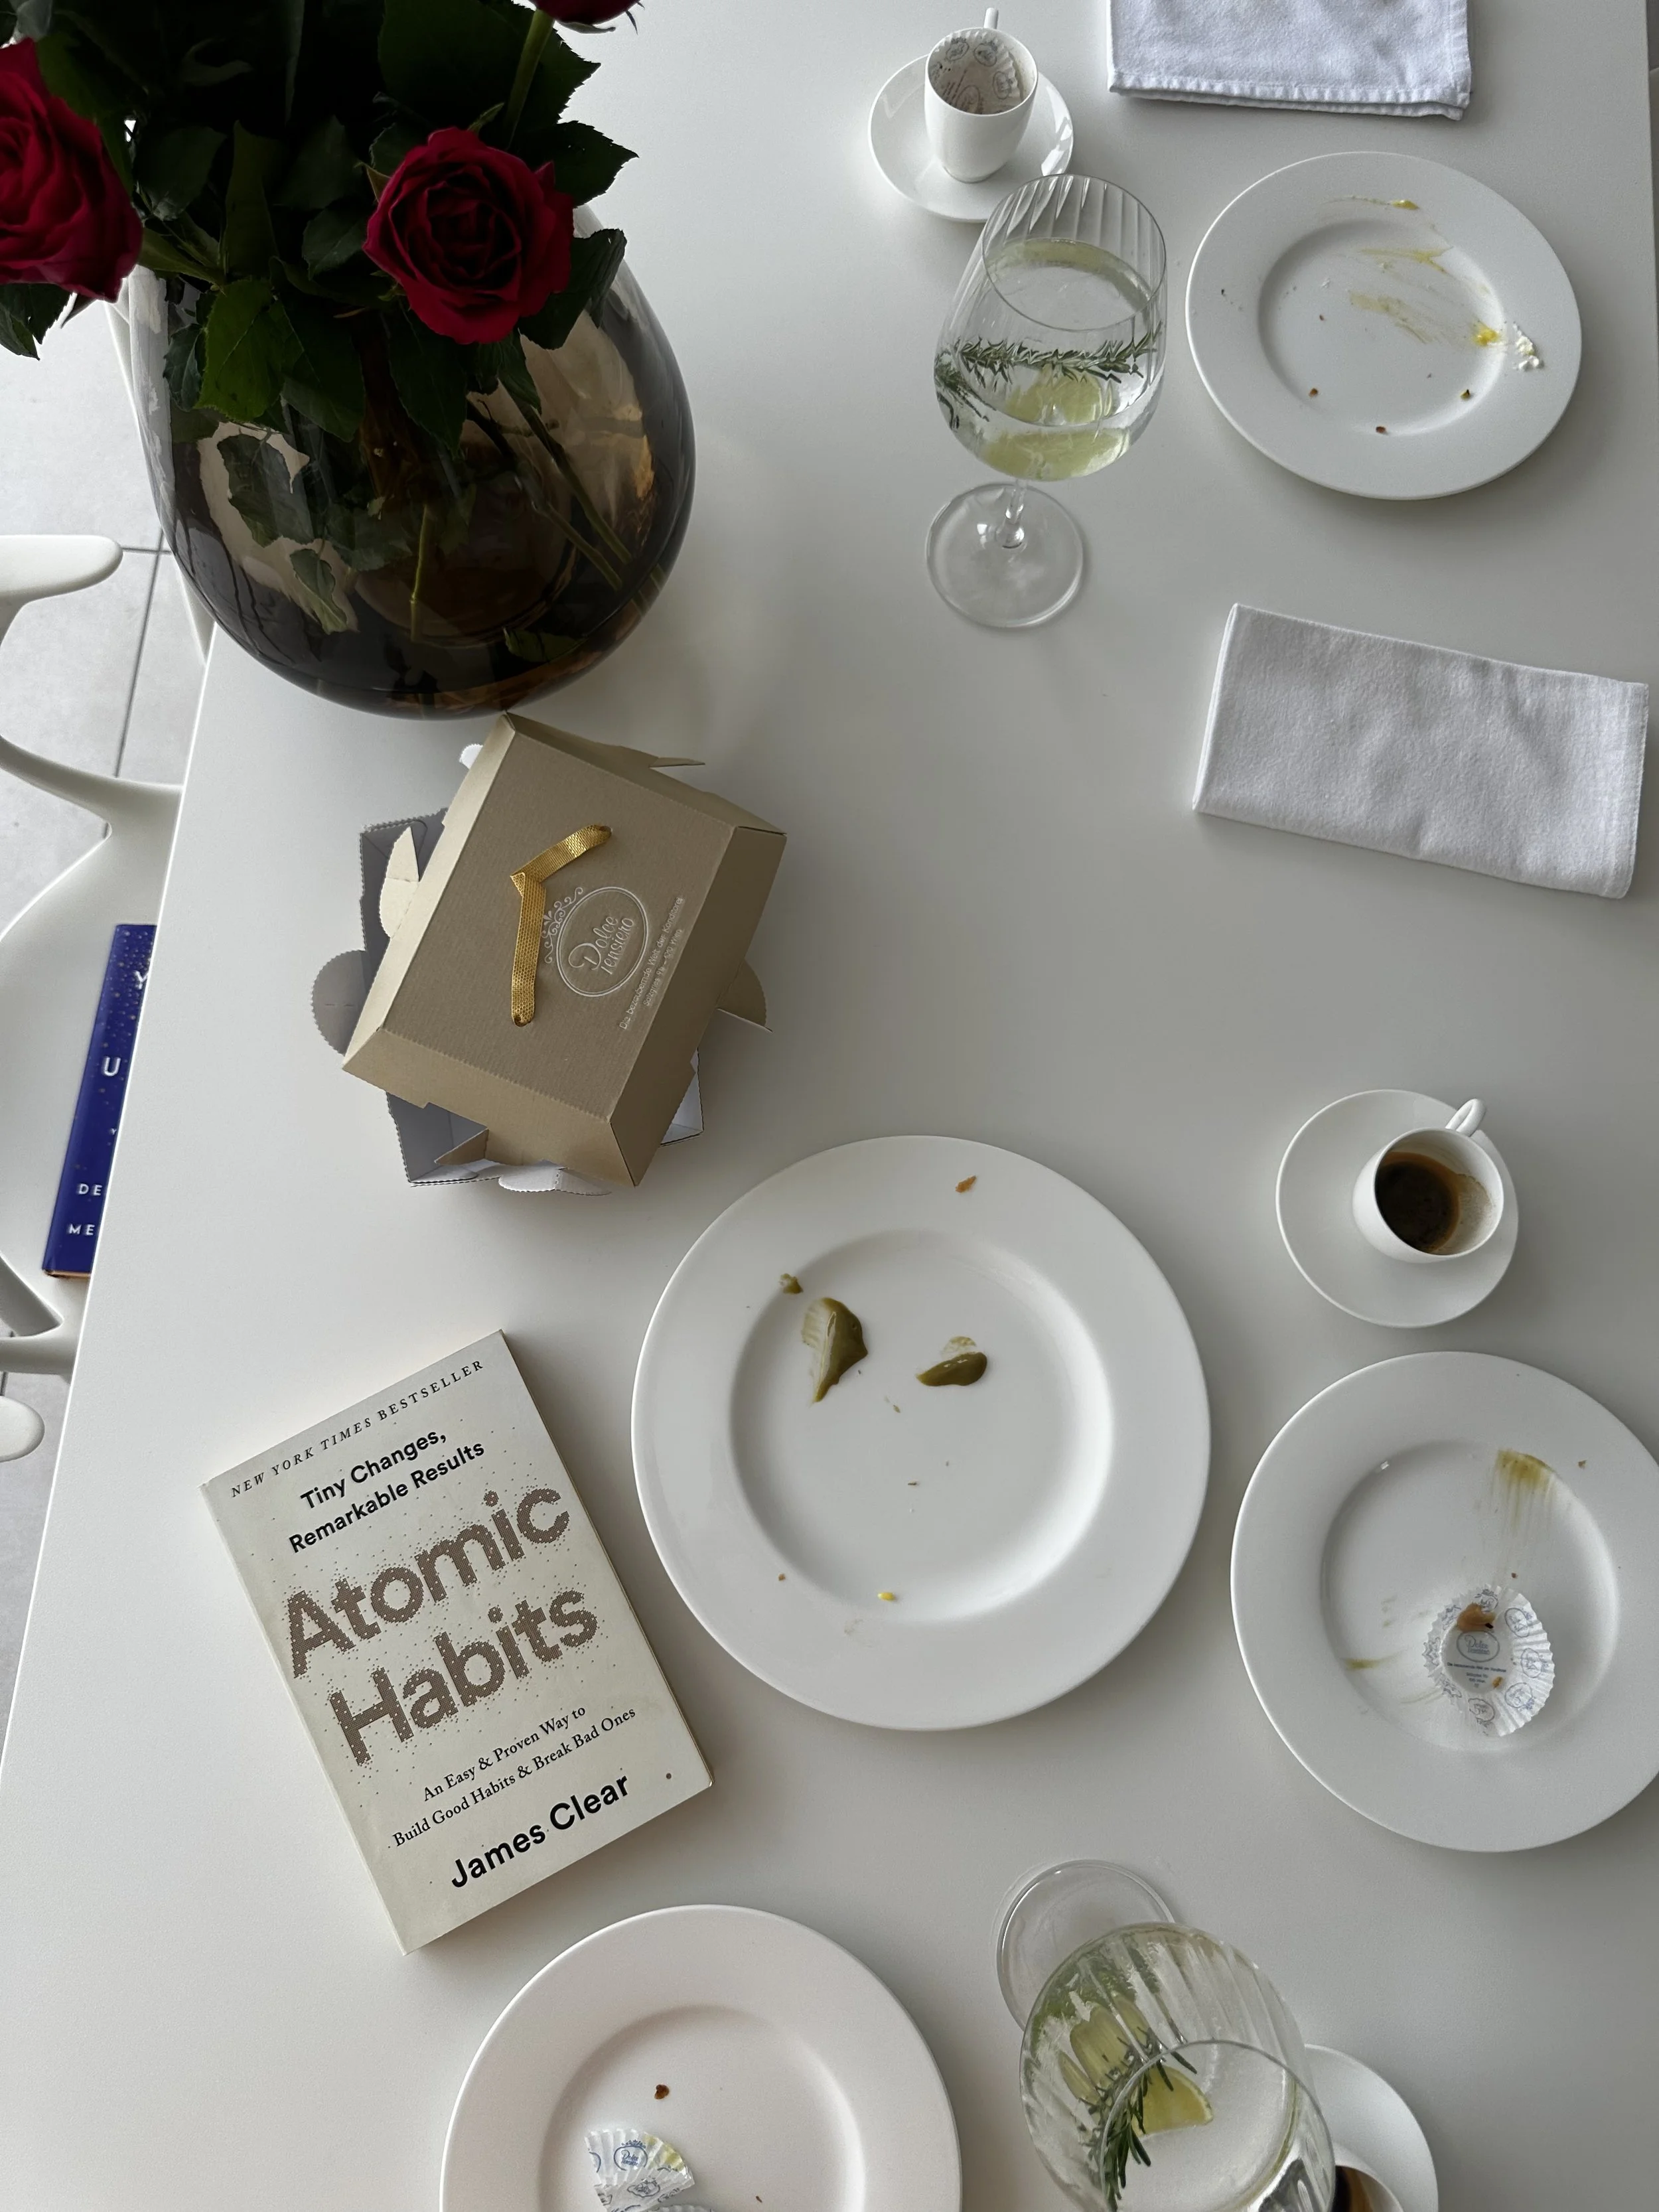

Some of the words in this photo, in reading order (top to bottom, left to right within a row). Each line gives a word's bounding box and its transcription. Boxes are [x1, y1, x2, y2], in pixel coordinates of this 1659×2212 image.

[569, 917, 618, 970] Dolce
[619, 1016, 630, 1029] Die
[647, 948, 660, 966] Welt
[657, 934, 667, 948] der
[232, 1472, 265, 1498] NEW
[271, 1446, 315, 1476] YORK
[321, 1418, 372, 1451] TIMES
[378, 1360, 484, 1421] BESTSELLER
[300, 1478, 346, 1509] Tiny
[350, 1430, 447, 1483] Changes,
[289, 1483, 409, 1553] Remarkable
[410, 1442, 485, 1489] Results
[287, 1488, 570, 1678] Atomic
[330, 1591, 598, 1766] Habits
[392, 1820, 431, 1847] Build
[431, 1797, 470, 1825] Good
[470, 1774, 516, 1805] Habits
[517, 1765, 533, 1778] &
[532, 1742, 573, 1771] Break
[572, 1725, 601, 1749] Bad
[601, 1708, 636, 1732] Ones
[423, 1786, 444, 1802] An
[444, 1766, 476, 1789] Easy
[478, 1757, 494, 1771] &
[492, 1732, 540, 1763] Proven
[539, 1715, 570, 1736] Way
[571, 1706, 586, 1720] to
[451, 1824, 547, 1888] James
[549, 1775, 629, 1830] Clear
